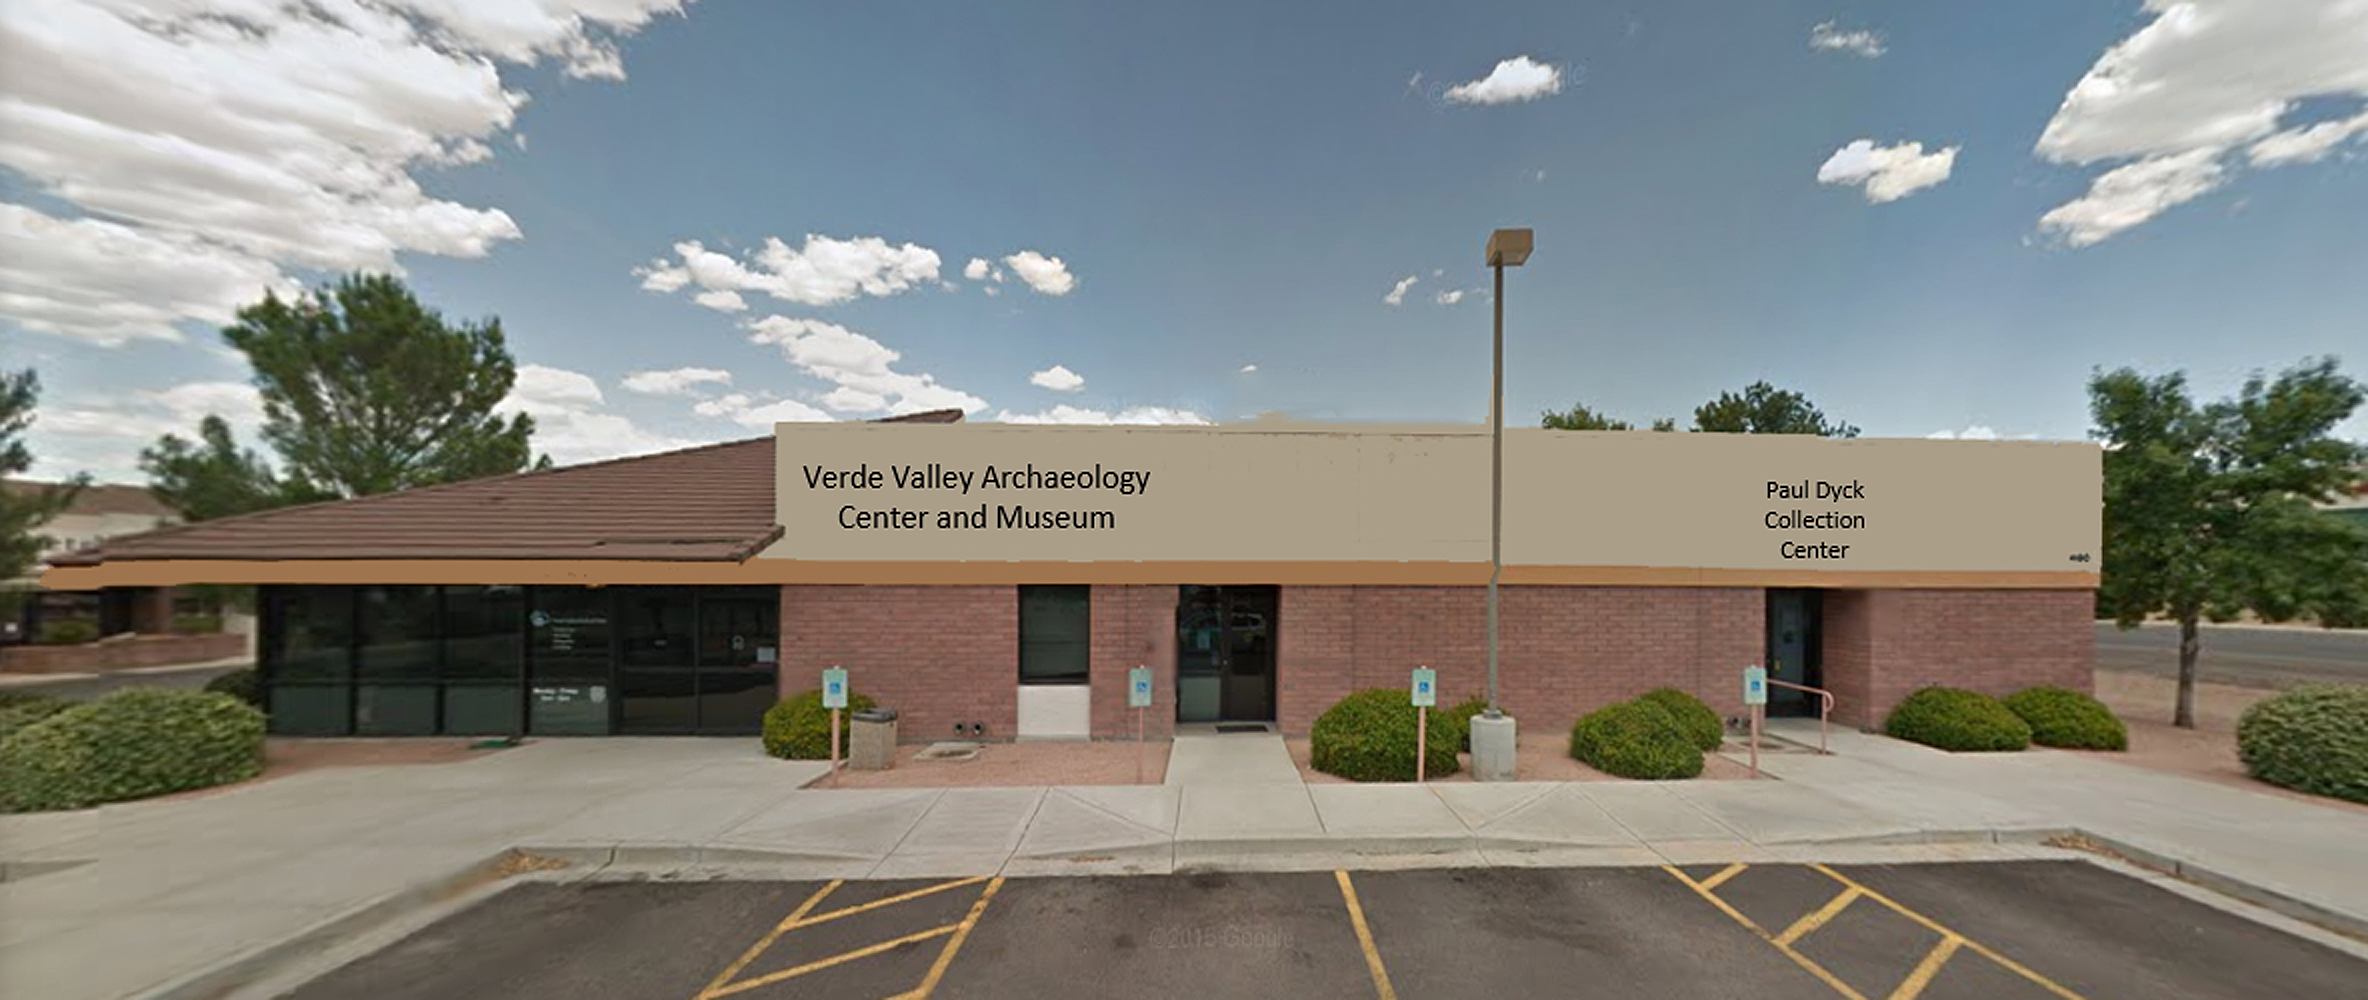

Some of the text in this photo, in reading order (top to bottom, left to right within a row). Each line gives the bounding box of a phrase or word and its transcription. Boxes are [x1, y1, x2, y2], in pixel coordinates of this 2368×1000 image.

[802, 463, 1151, 495] Verde Valley Archaeology
[1766, 480, 1865, 503] Paul Dyck
[838, 503, 1115, 529] Center and Museum
[1764, 509, 1866, 529] Collection
[1780, 541, 1851, 559] Center
